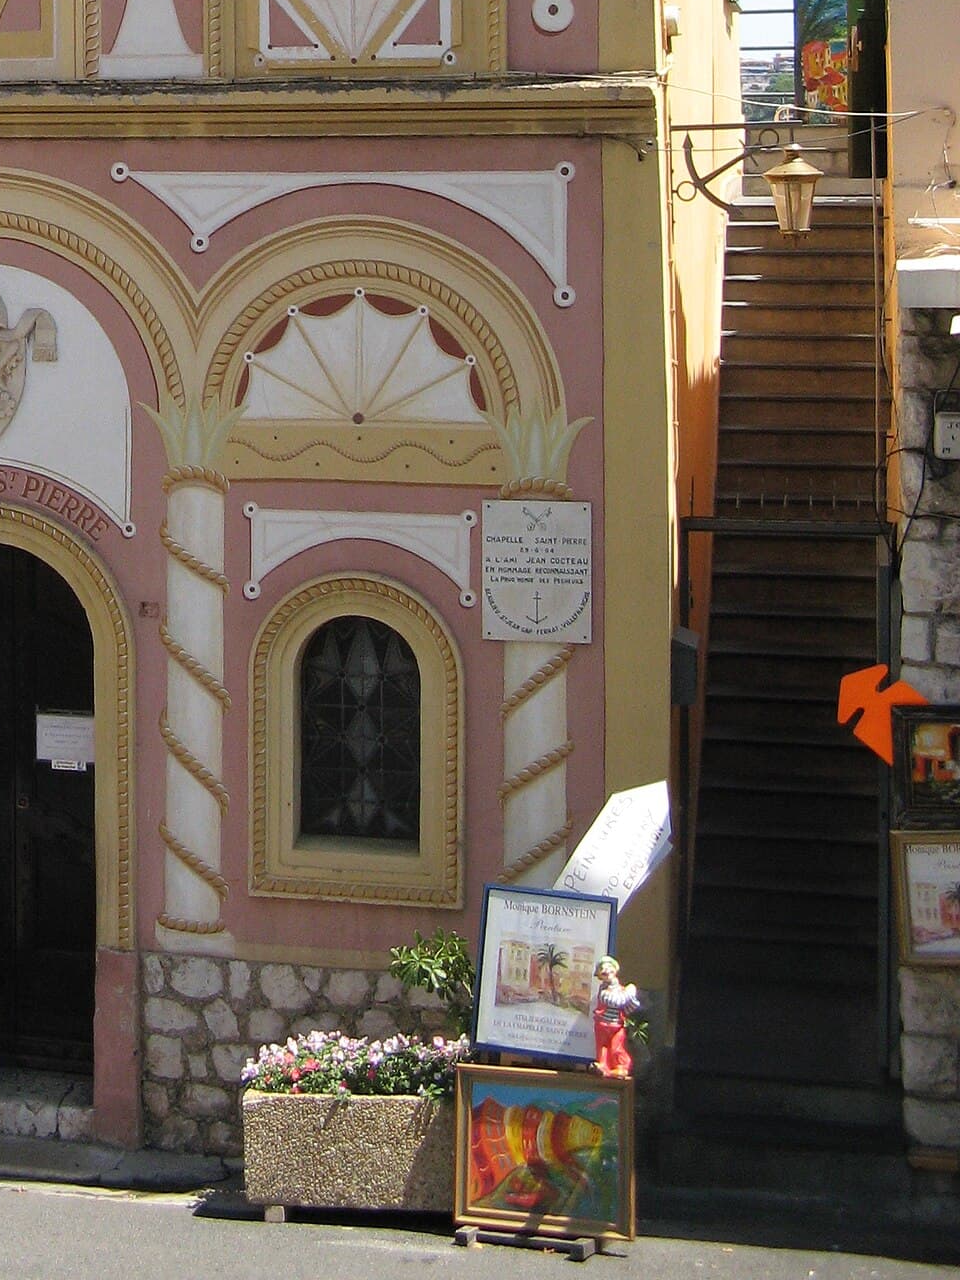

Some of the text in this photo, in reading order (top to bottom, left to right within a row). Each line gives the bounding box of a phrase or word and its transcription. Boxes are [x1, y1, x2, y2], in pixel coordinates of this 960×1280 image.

[20, 474, 109, 541] PIERRE
[486, 536, 524, 544] CHAPELLE
[526, 556, 546, 565] JEAN
[550, 557, 589, 566] COCTEAU
[498, 567, 531, 575] HOMMAGE
[503, 899, 597, 920] Monique BORNSTEIN
